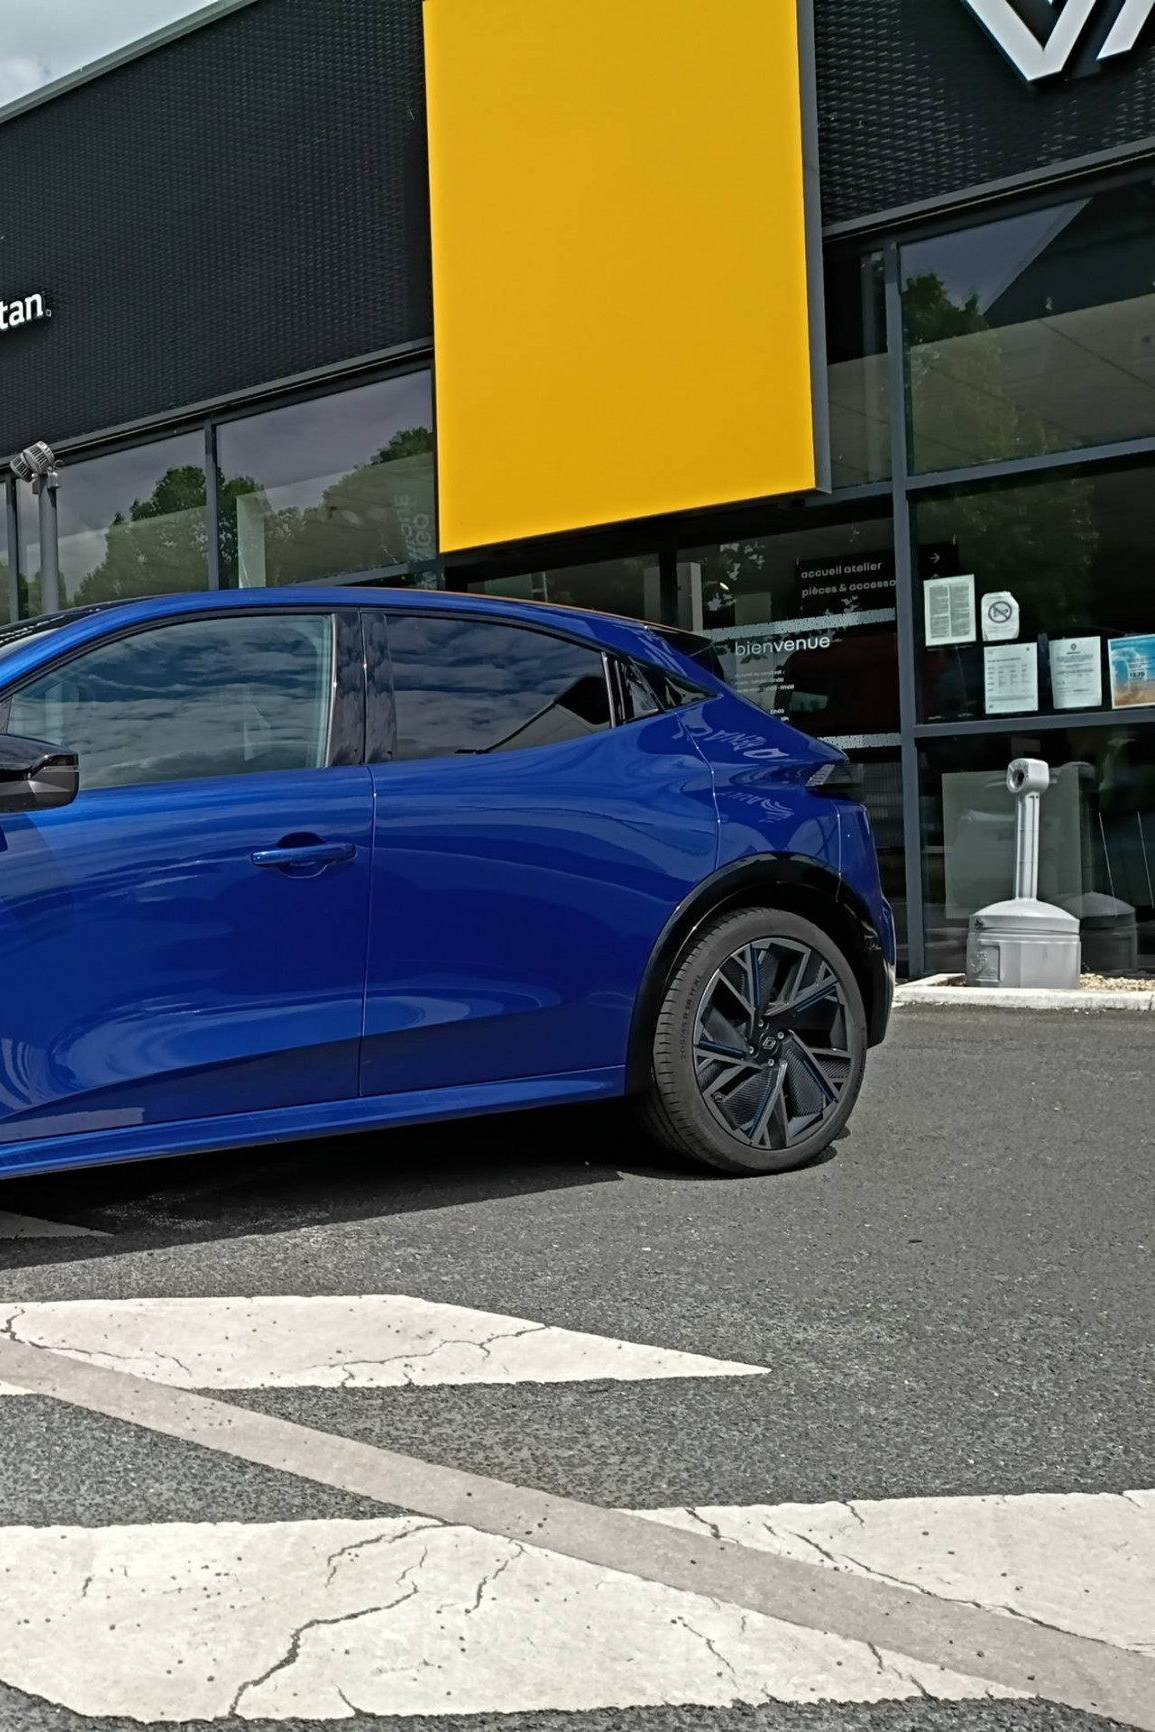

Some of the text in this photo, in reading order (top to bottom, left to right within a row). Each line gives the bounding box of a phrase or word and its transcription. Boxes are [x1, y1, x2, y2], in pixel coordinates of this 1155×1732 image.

[801, 562, 883, 579] accueil atelier
[802, 585, 838, 599] pièces
[839, 584, 847, 592] &
[735, 636, 830, 656] bienvenue
